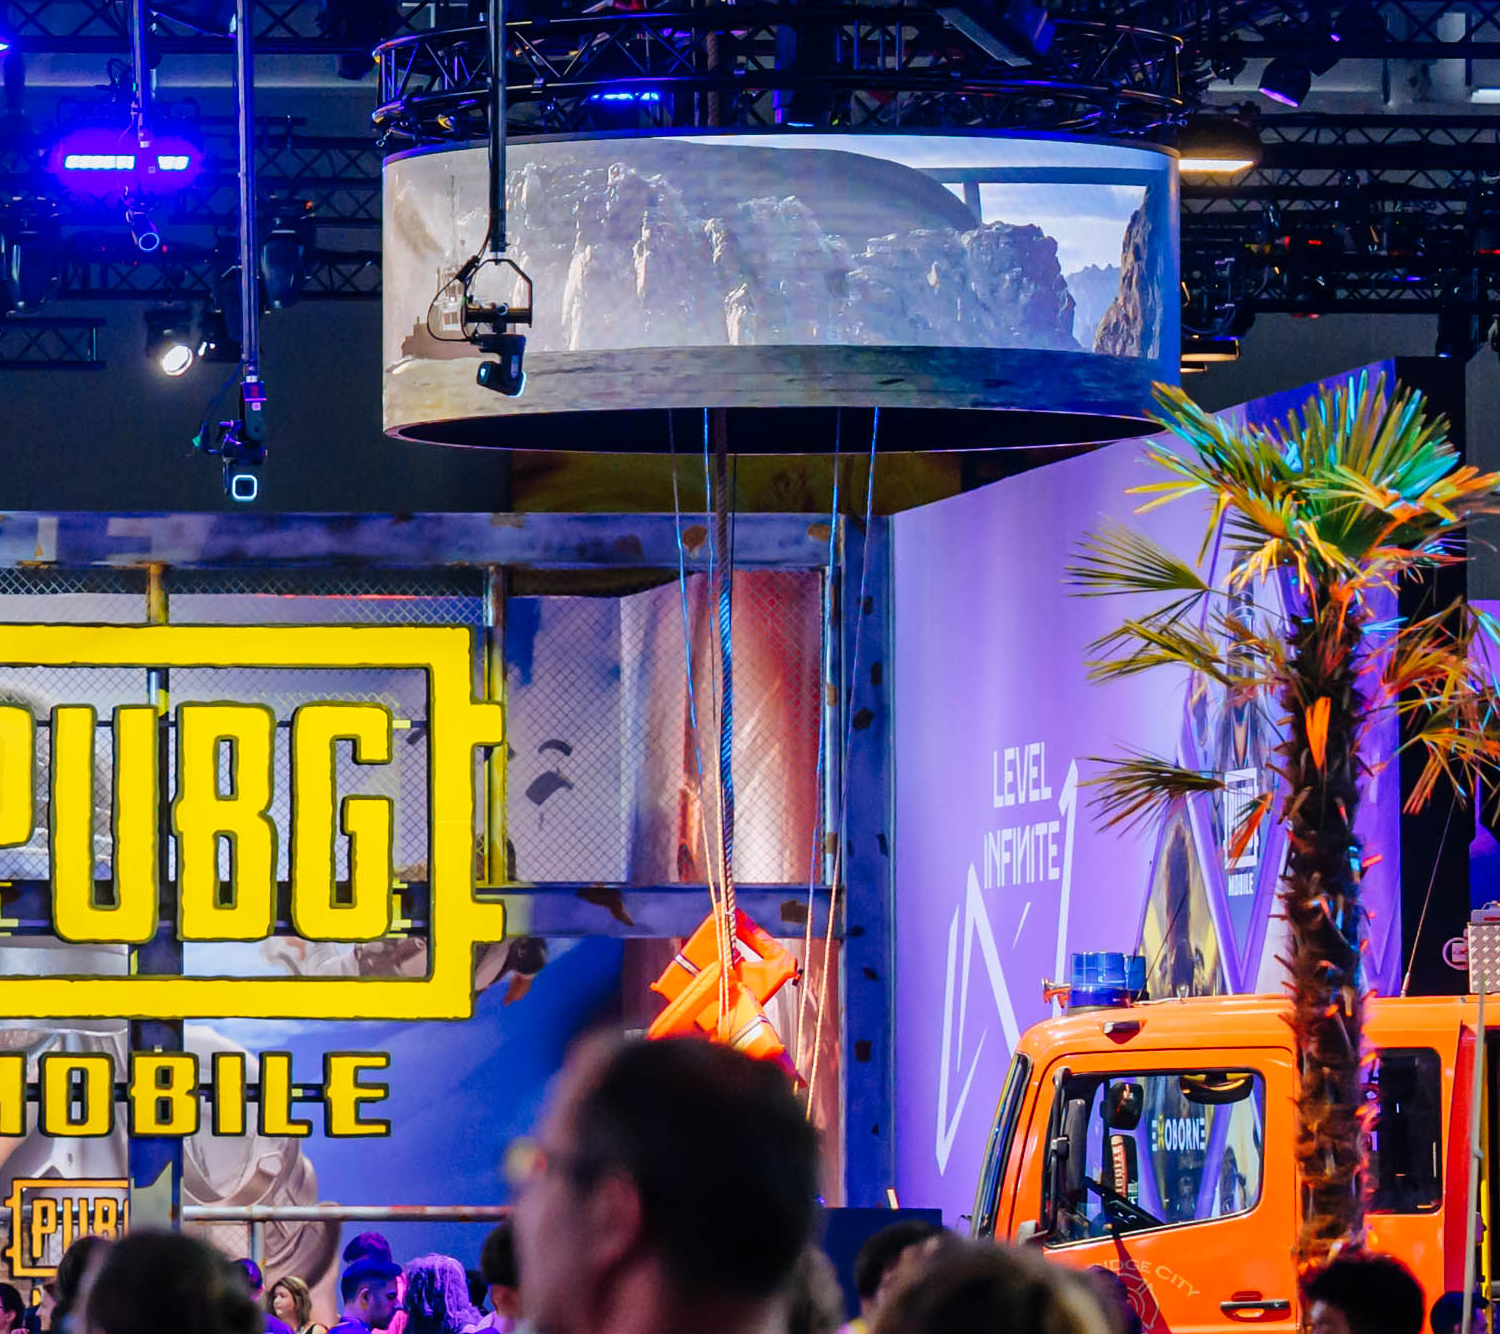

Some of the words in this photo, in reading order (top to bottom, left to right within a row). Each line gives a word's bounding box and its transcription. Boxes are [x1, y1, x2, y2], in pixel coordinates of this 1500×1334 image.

[993, 741, 1052, 808] LEVEL
[984, 820, 1060, 889] INFINITE
[31, 1197, 128, 1259] PUB
[1155, 1265, 1200, 1297] CITY
